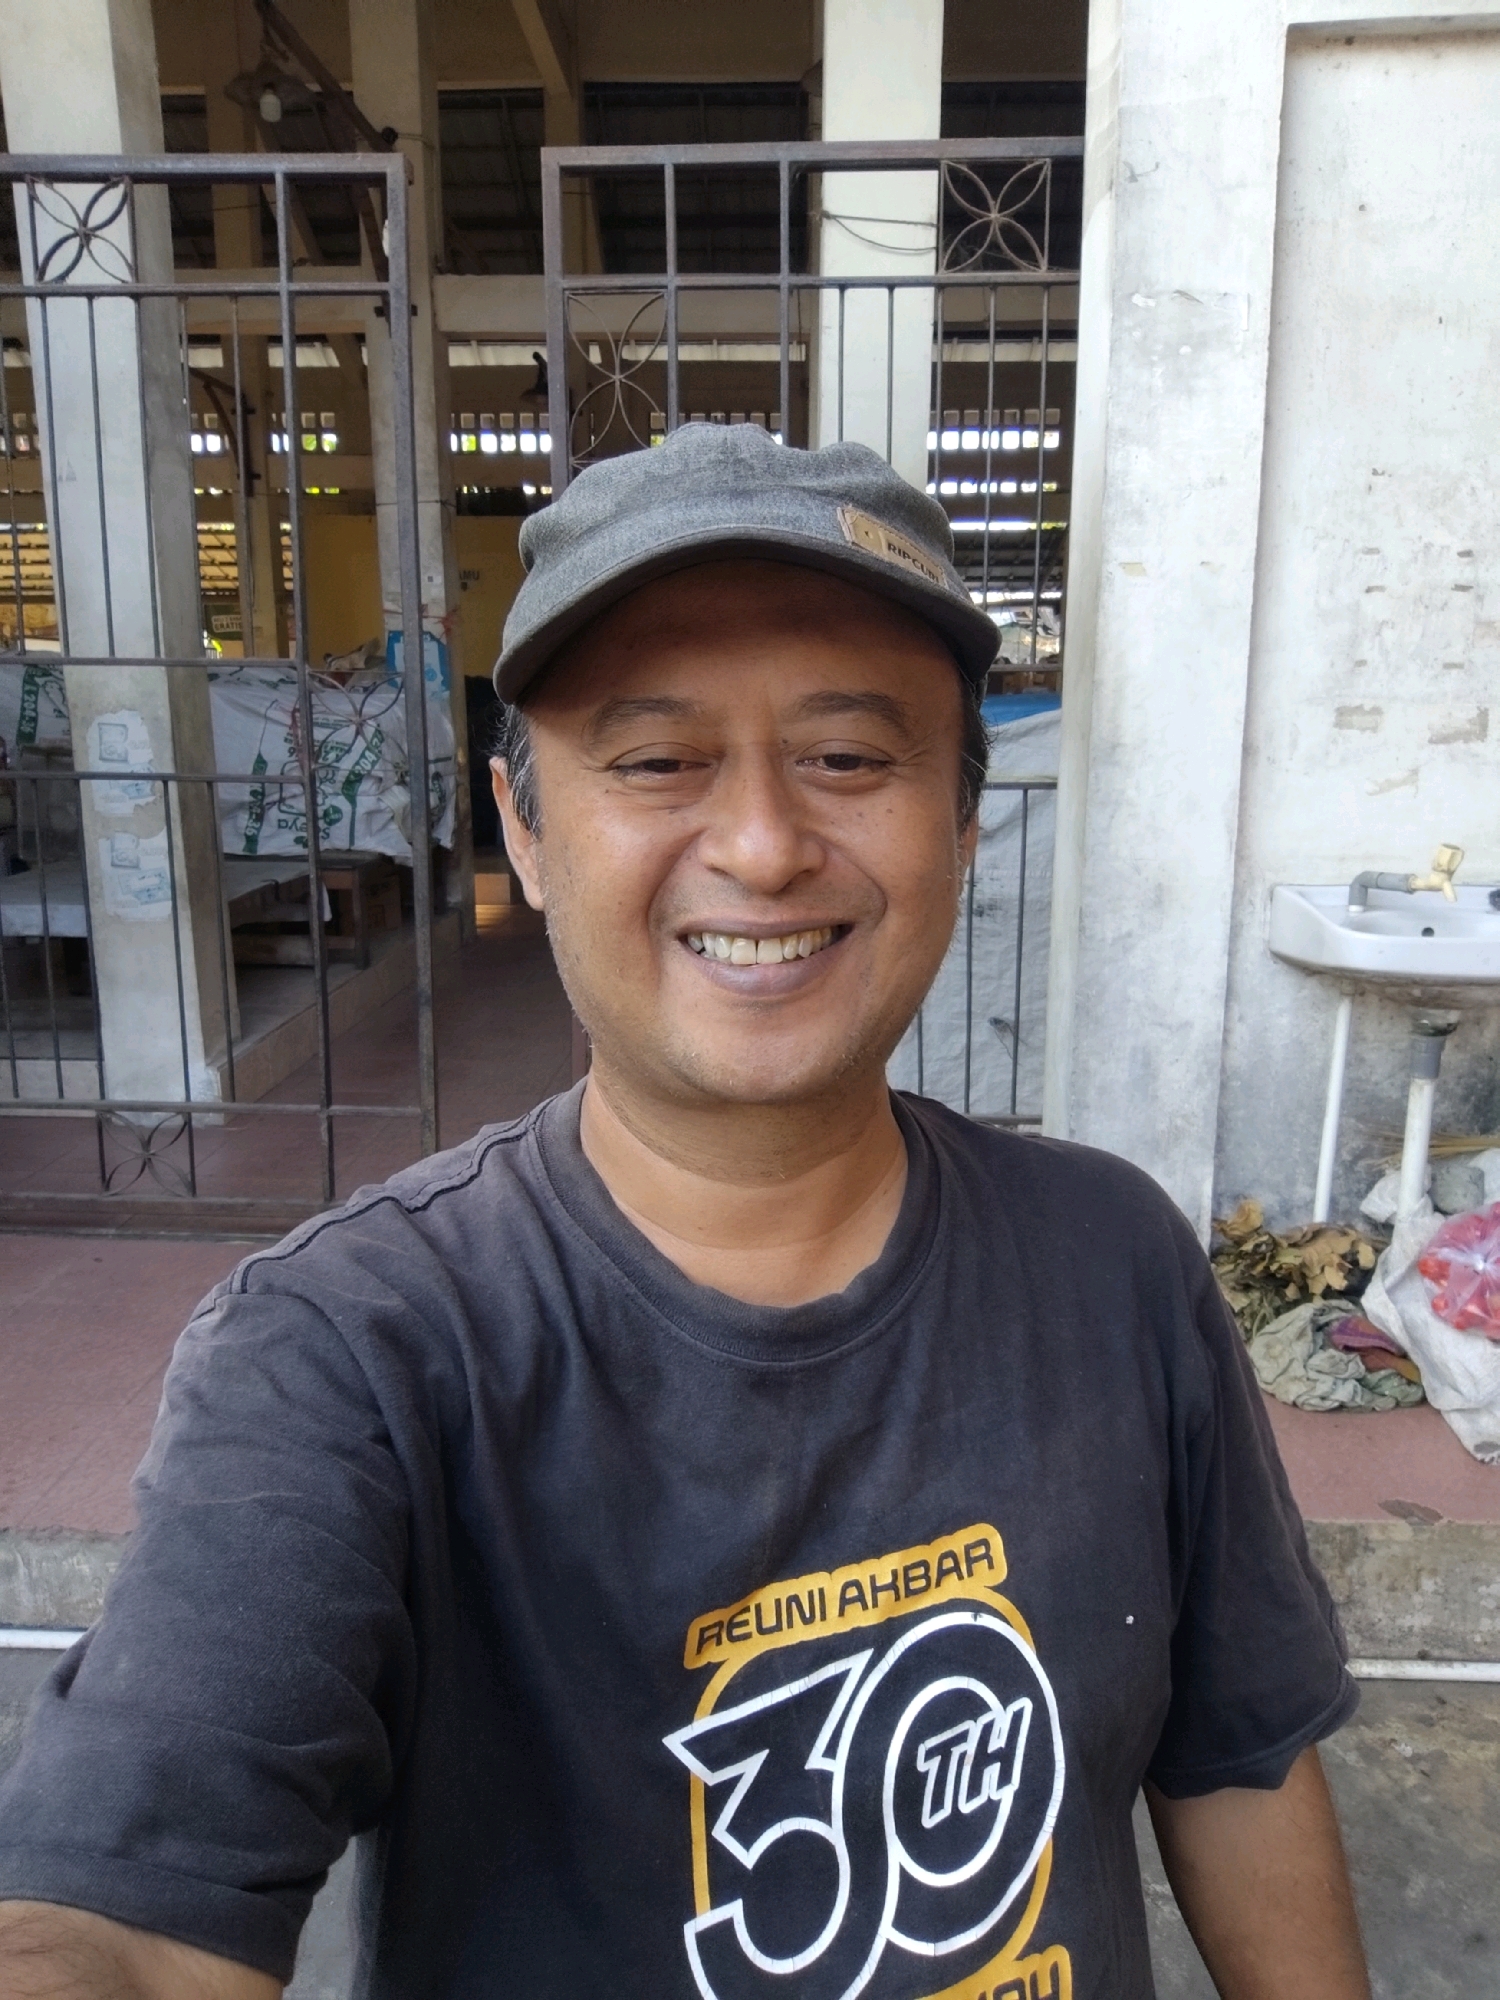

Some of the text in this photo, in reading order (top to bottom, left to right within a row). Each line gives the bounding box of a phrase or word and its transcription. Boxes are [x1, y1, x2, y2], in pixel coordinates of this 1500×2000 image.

[888, 542, 911, 560] RIP
[696, 1537, 996, 1656] REUNI AKBAR
[662, 1611, 1066, 2000] 30
[917, 1697, 1033, 1828] TH
